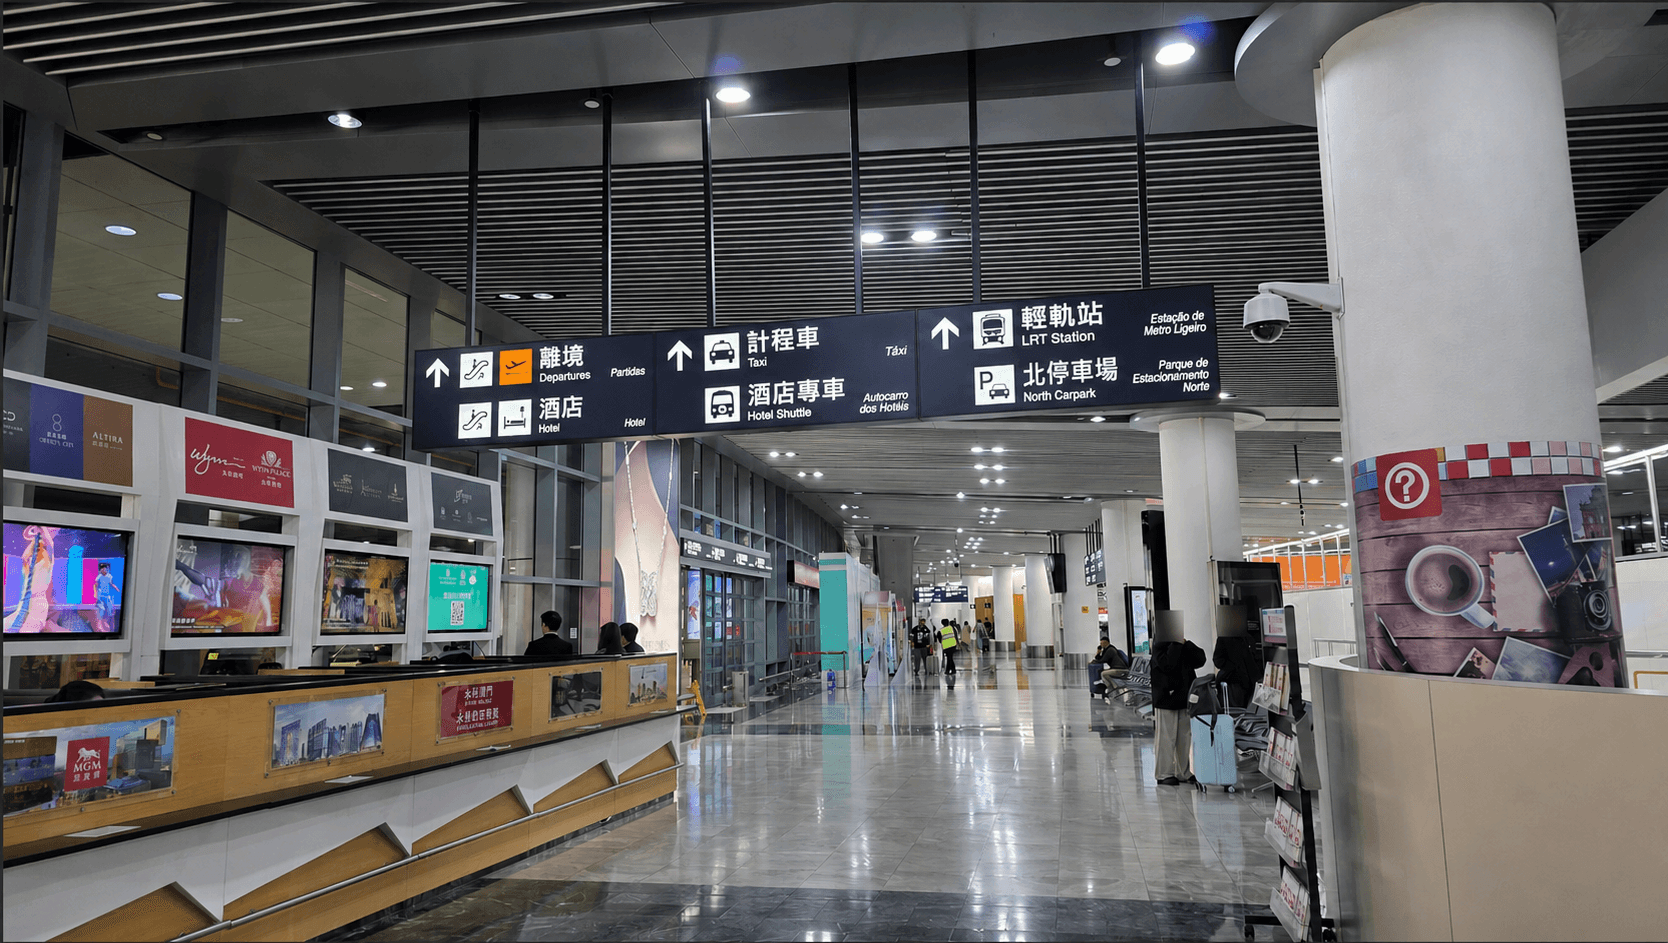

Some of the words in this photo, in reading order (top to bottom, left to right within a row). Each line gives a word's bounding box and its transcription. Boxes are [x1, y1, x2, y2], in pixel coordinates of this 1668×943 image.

[1021, 300, 1104, 330] 輕軌站
[1150, 311, 1190, 324] Estação
[1191, 310, 1205, 321] de
[1143, 325, 1172, 336] Metro
[1173, 321, 1207, 336] Ligeiro
[746, 325, 820, 354] 計程車
[1021, 333, 1048, 346] LRT
[1051, 331, 1096, 344] Station
[539, 344, 584, 369] 離境
[885, 345, 908, 356] Táxi
[747, 357, 768, 368] Taxi
[1158, 360, 1194, 371] Parque
[1195, 357, 1209, 368] de
[539, 371, 591, 384] Departures
[610, 366, 646, 377] Partidas
[1023, 356, 1119, 387] 北停車場
[1132, 370, 1210, 384] Estacionamento
[748, 377, 846, 407] 酒店專車
[1182, 381, 1210, 393] Norte
[862, 392, 909, 403] Autocarro
[1023, 390, 1052, 402] North
[1054, 388, 1097, 401] Carpark
[538, 395, 584, 420] 酒店
[747, 410, 774, 421] Hotel
[776, 407, 812, 419] Shuttle
[859, 404, 877, 414] dos
[879, 401, 909, 413] Hotéis
[538, 423, 560, 434] Hotel
[624, 417, 647, 428] Hotel
[92, 431, 124, 444] ALTIRA
[73, 760, 101, 773] MGM
